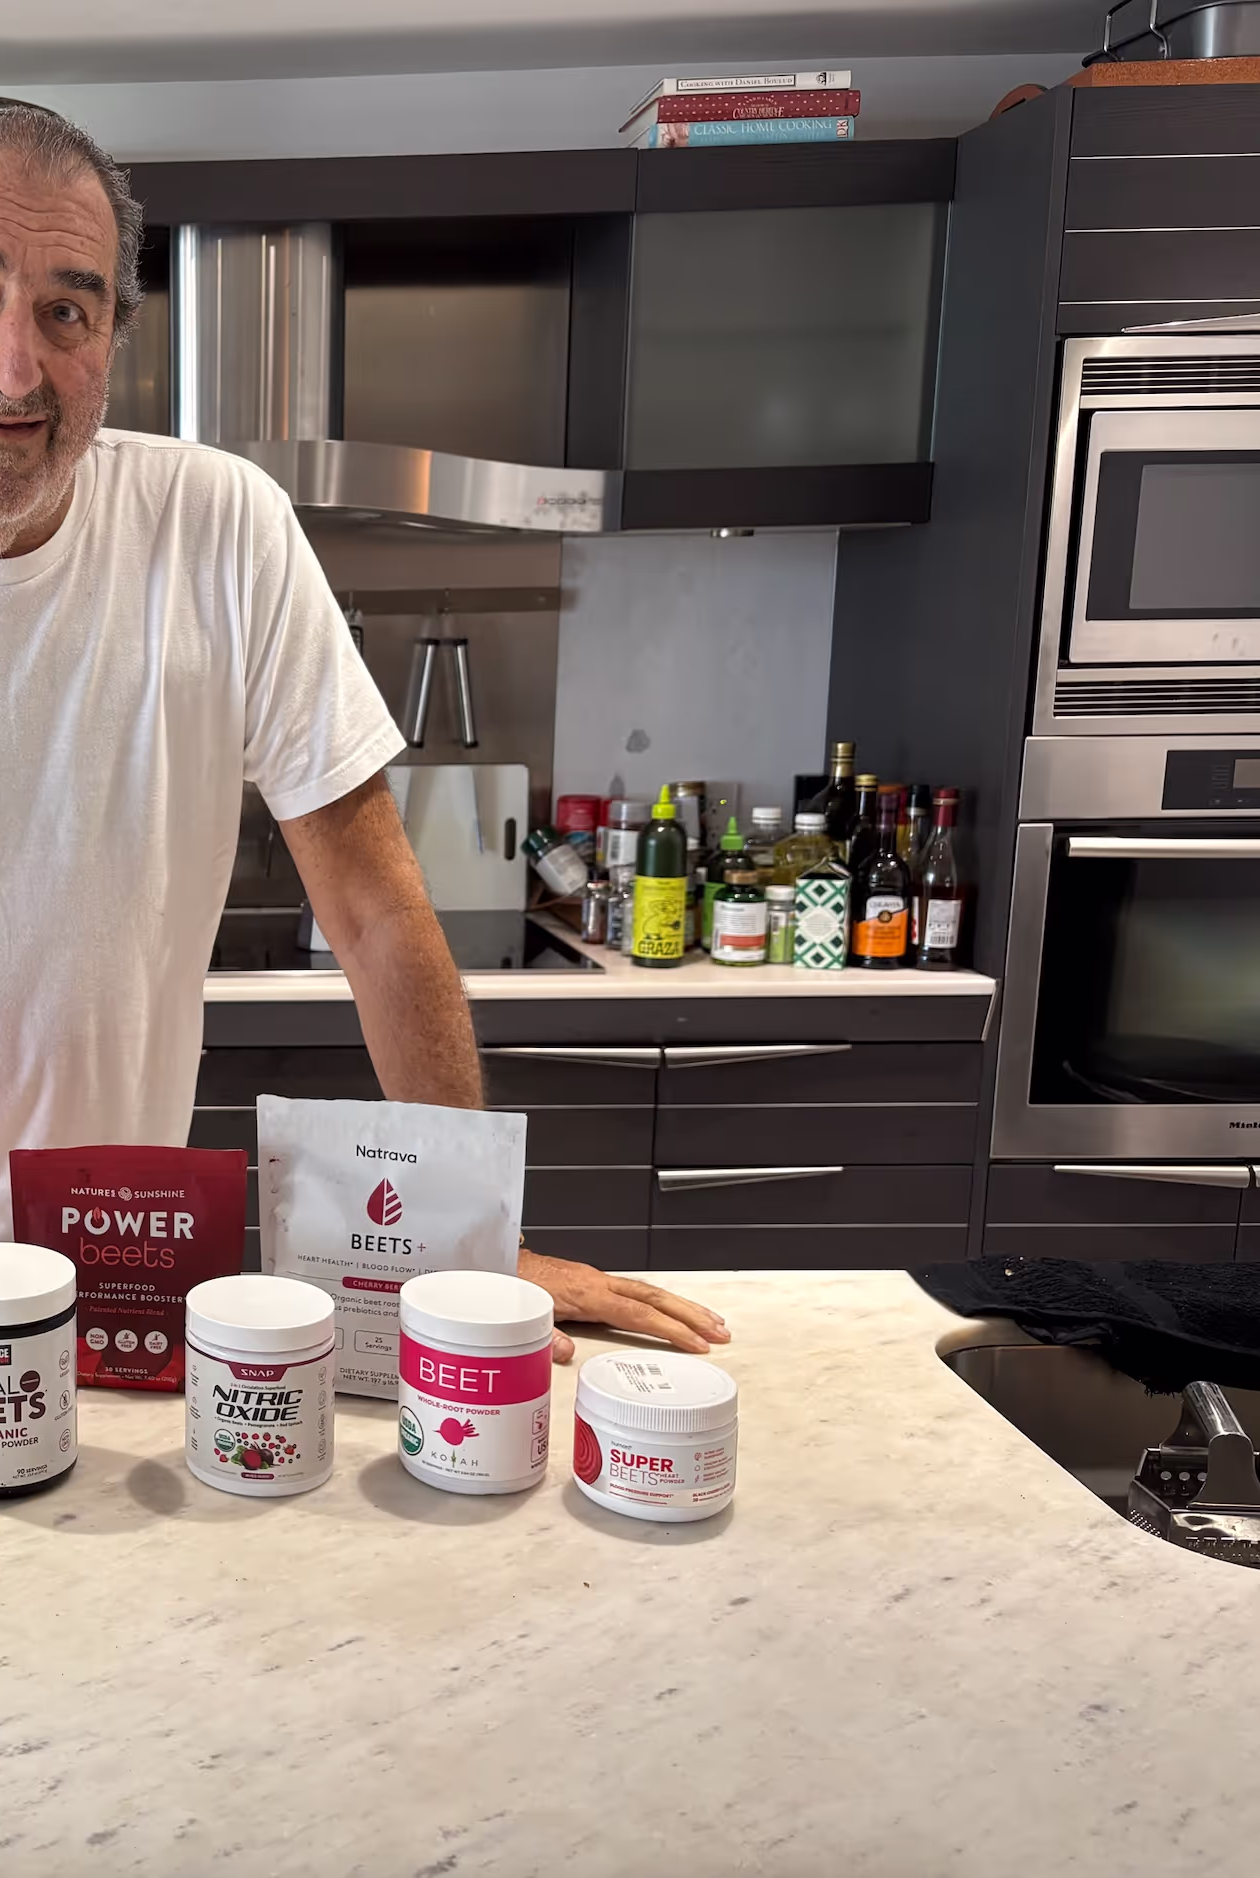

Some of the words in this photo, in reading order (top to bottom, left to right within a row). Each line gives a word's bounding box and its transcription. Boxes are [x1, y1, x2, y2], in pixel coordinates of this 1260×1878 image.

[764, 77, 793, 85] BOULUD
[694, 124, 738, 136] CLASSIC
[779, 119, 832, 131] COOKING
[836, 119, 848, 138] DK
[639, 941, 678, 956] GRAZA
[356, 1144, 417, 1164] Natrava
[134, 1189, 185, 1199] SUNSHINE
[61, 1206, 195, 1240] POWER
[351, 1233, 412, 1255] BEETS
[80, 1237, 175, 1269] beets
[297, 1254, 320, 1263] HEART
[362, 1262, 389, 1272] BLOOD
[99, 1282, 156, 1292] SUPERFOOD
[352, 1280, 383, 1290] CHERRY
[140, 1294, 183, 1304] BOOSTER
[331, 1292, 362, 1304] Organic
[363, 1297, 382, 1307] beet
[383, 1299, 400, 1308] root
[89, 1305, 118, 1314] Patented
[118, 1307, 145, 1315] Nutrient
[343, 1305, 382, 1317] prebiotics
[383, 1309, 399, 1318] and
[365, 1341, 392, 1352] Servings
[375, 1336, 383, 1344] 25
[240, 1368, 275, 1377] SNAP
[339, 1367, 370, 1376] DIETARY
[419, 1356, 501, 1394] BEET
[212, 1385, 303, 1406] NITRIC
[216, 1402, 300, 1422] OXIDE
[417, 1394, 464, 1414] WHOLE-ROOT
[465, 1408, 501, 1416] POWDER
[1, 1436, 39, 1449] POWDER
[610, 1448, 674, 1473] SUPER
[609, 1462, 659, 1486] BEETS
[609, 1482, 625, 1491] BLOOD
[625, 1487, 649, 1497] PRESSURE
